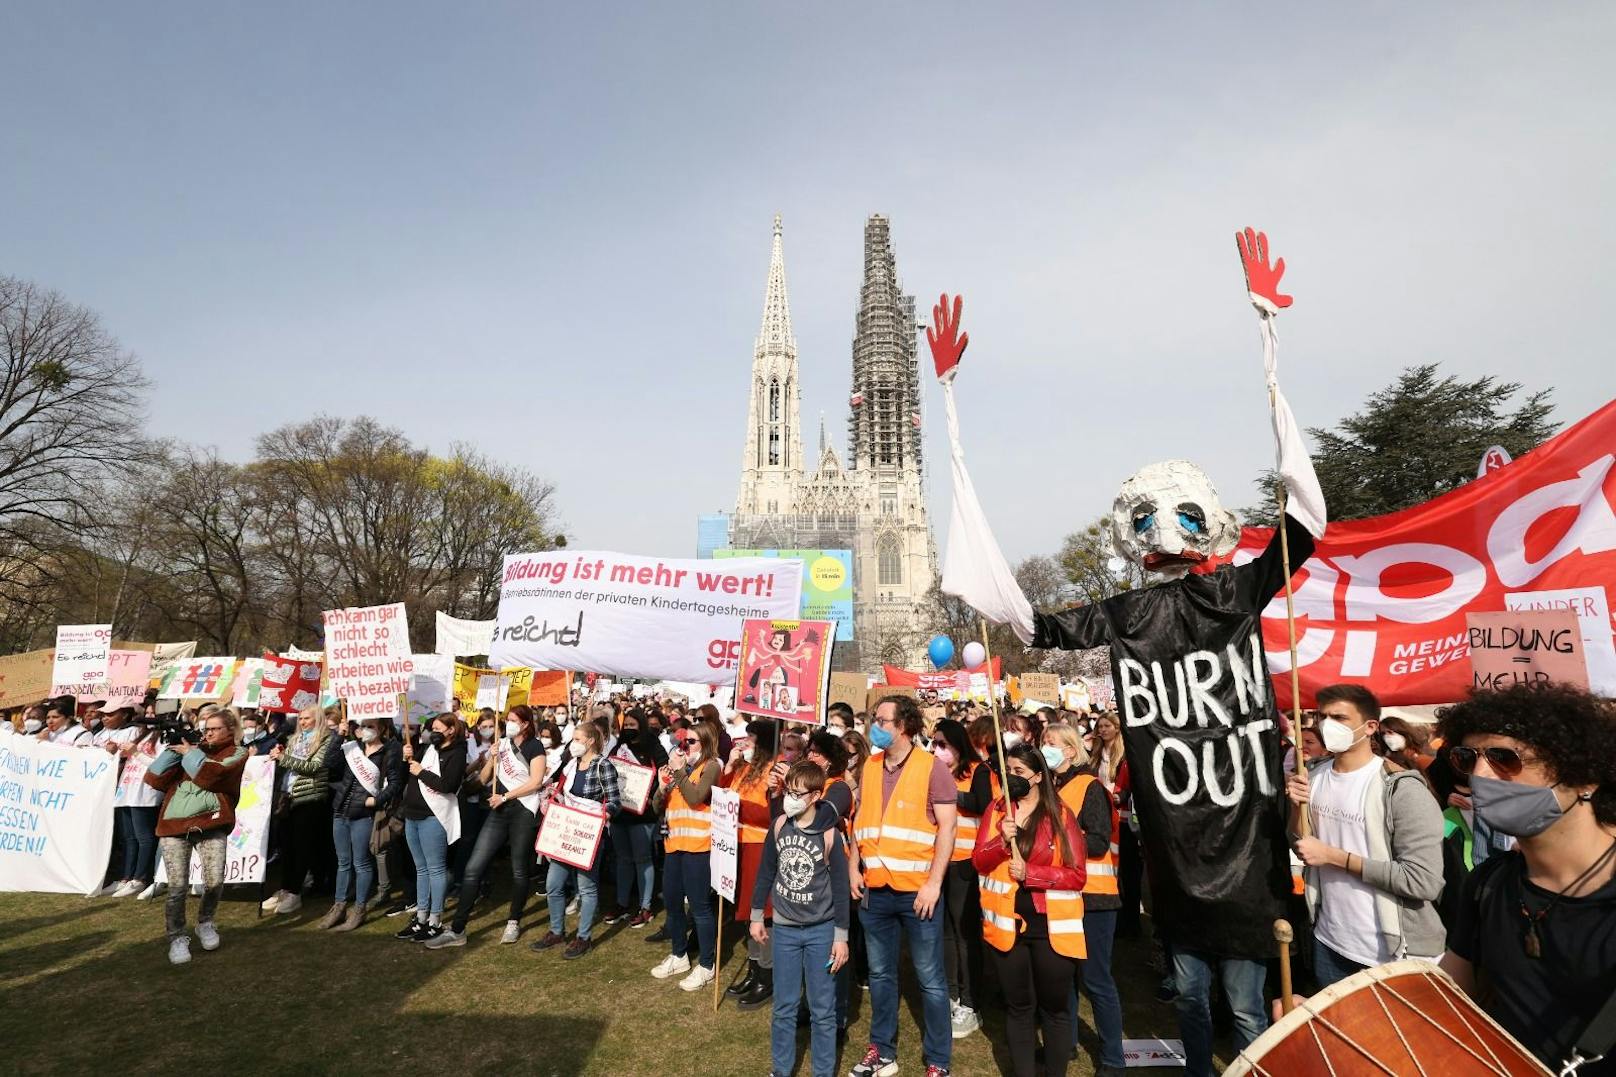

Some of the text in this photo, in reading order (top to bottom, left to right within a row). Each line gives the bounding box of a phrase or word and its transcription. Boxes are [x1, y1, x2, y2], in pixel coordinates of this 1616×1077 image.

[504, 557, 774, 597] Bildung ist mehr wert!
[344, 608, 376, 624] kann
[379, 606, 398, 623] gar
[575, 589, 594, 601] der
[597, 592, 647, 607] privaten
[651, 596, 769, 618] Kindertagesheime
[334, 625, 389, 641] nicht so
[503, 610, 583, 647] reicht!
[1469, 627, 1574, 653] BILDUNG
[333, 641, 388, 660] schlecht
[707, 639, 740, 669] gp
[328, 657, 413, 679] arbeiten wie
[334, 677, 409, 698] ich bezahlt
[1119, 633, 1267, 728] BURN
[37, 759, 67, 778] WIE
[1153, 719, 1277, 808] OUT
[790, 893, 814, 902] YORK
